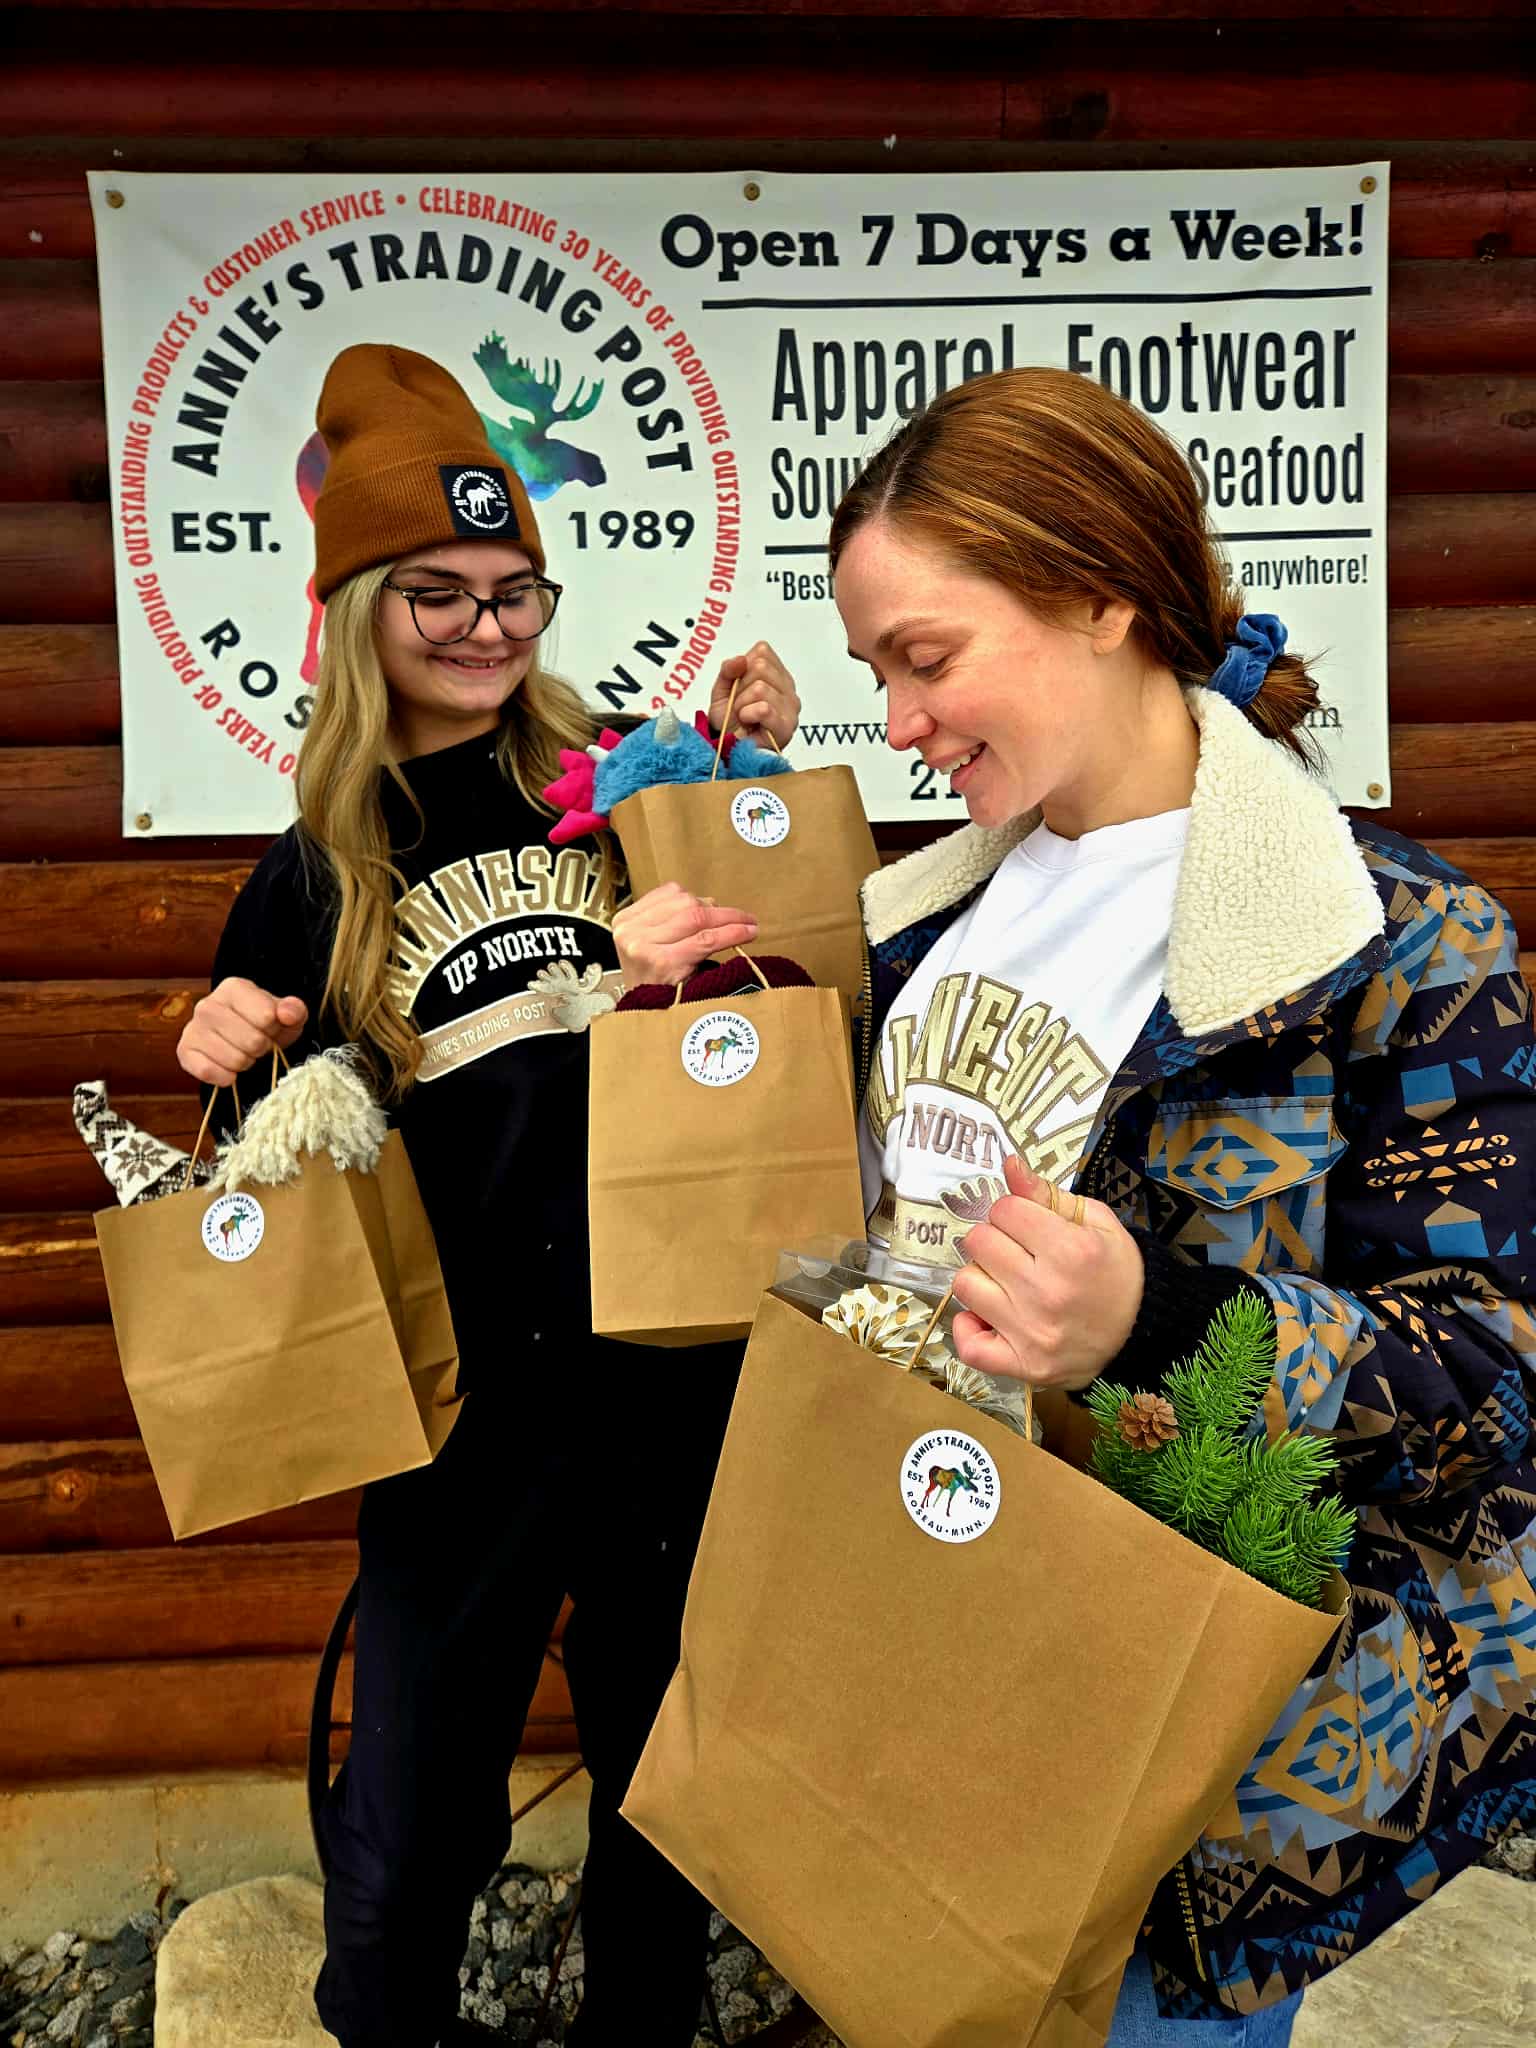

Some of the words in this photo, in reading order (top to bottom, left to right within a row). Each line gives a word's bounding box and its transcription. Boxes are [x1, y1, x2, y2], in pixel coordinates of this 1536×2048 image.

[299, 189, 386, 236] SERVICE
[418, 186, 558, 244] CELEBRATING
[661, 213, 840, 282] Open
[861, 215, 895, 266] 7
[916, 213, 1088, 278] Days
[1109, 226, 1151, 262] a
[1170, 203, 1364, 261] Week!
[203, 219, 301, 298] CUSTOMER
[560, 230, 591, 260] 30
[188, 296, 209, 316] &
[592, 248, 652, 309] YEARS
[645, 305, 674, 332] OF
[132, 311, 198, 417] PRODUCTS
[171, 262, 325, 477] ANNIE'S
[327, 231, 603, 333] TRADING
[594, 325, 693, 472] POST
[1068, 322, 1357, 414] Footwear
[664, 331, 730, 445] PROVIDING
[120, 421, 153, 567] OUTSTANDING
[1188, 432, 1364, 508] Seafood
[171, 512, 281, 553] EST.
[568, 510, 695, 549] 1989
[709, 450, 740, 592] OUTSTANDING
[1241, 554, 1368, 590] anywhere!
[133, 572, 204, 685] PROVIDING
[663, 597, 728, 700] PRODUCTS
[193, 684, 223, 711] OF
[200, 618, 315, 730] ROS
[595, 617, 695, 711] NN.
[216, 707, 277, 764] YEARS
[800, 722, 888, 746] www
[277, 753, 297, 781] 0
[442, 950, 479, 995] UP
[481, 926, 583, 971] NORTH
[461, 1012, 511, 1048] TRADING
[513, 1001, 547, 1024] POST
[906, 1102, 999, 1169] NORT
[905, 1216, 948, 1246] POST
[907, 1470, 924, 1484] EST.
[969, 1495, 991, 1510] 1989
[911, 1437, 943, 1468] ANNIE'S
[944, 1436, 986, 1466] TRADING
[982, 1467, 994, 1497] POST
[907, 1491, 943, 1533] ROSEAU
[951, 1519, 986, 1537] MINN.
